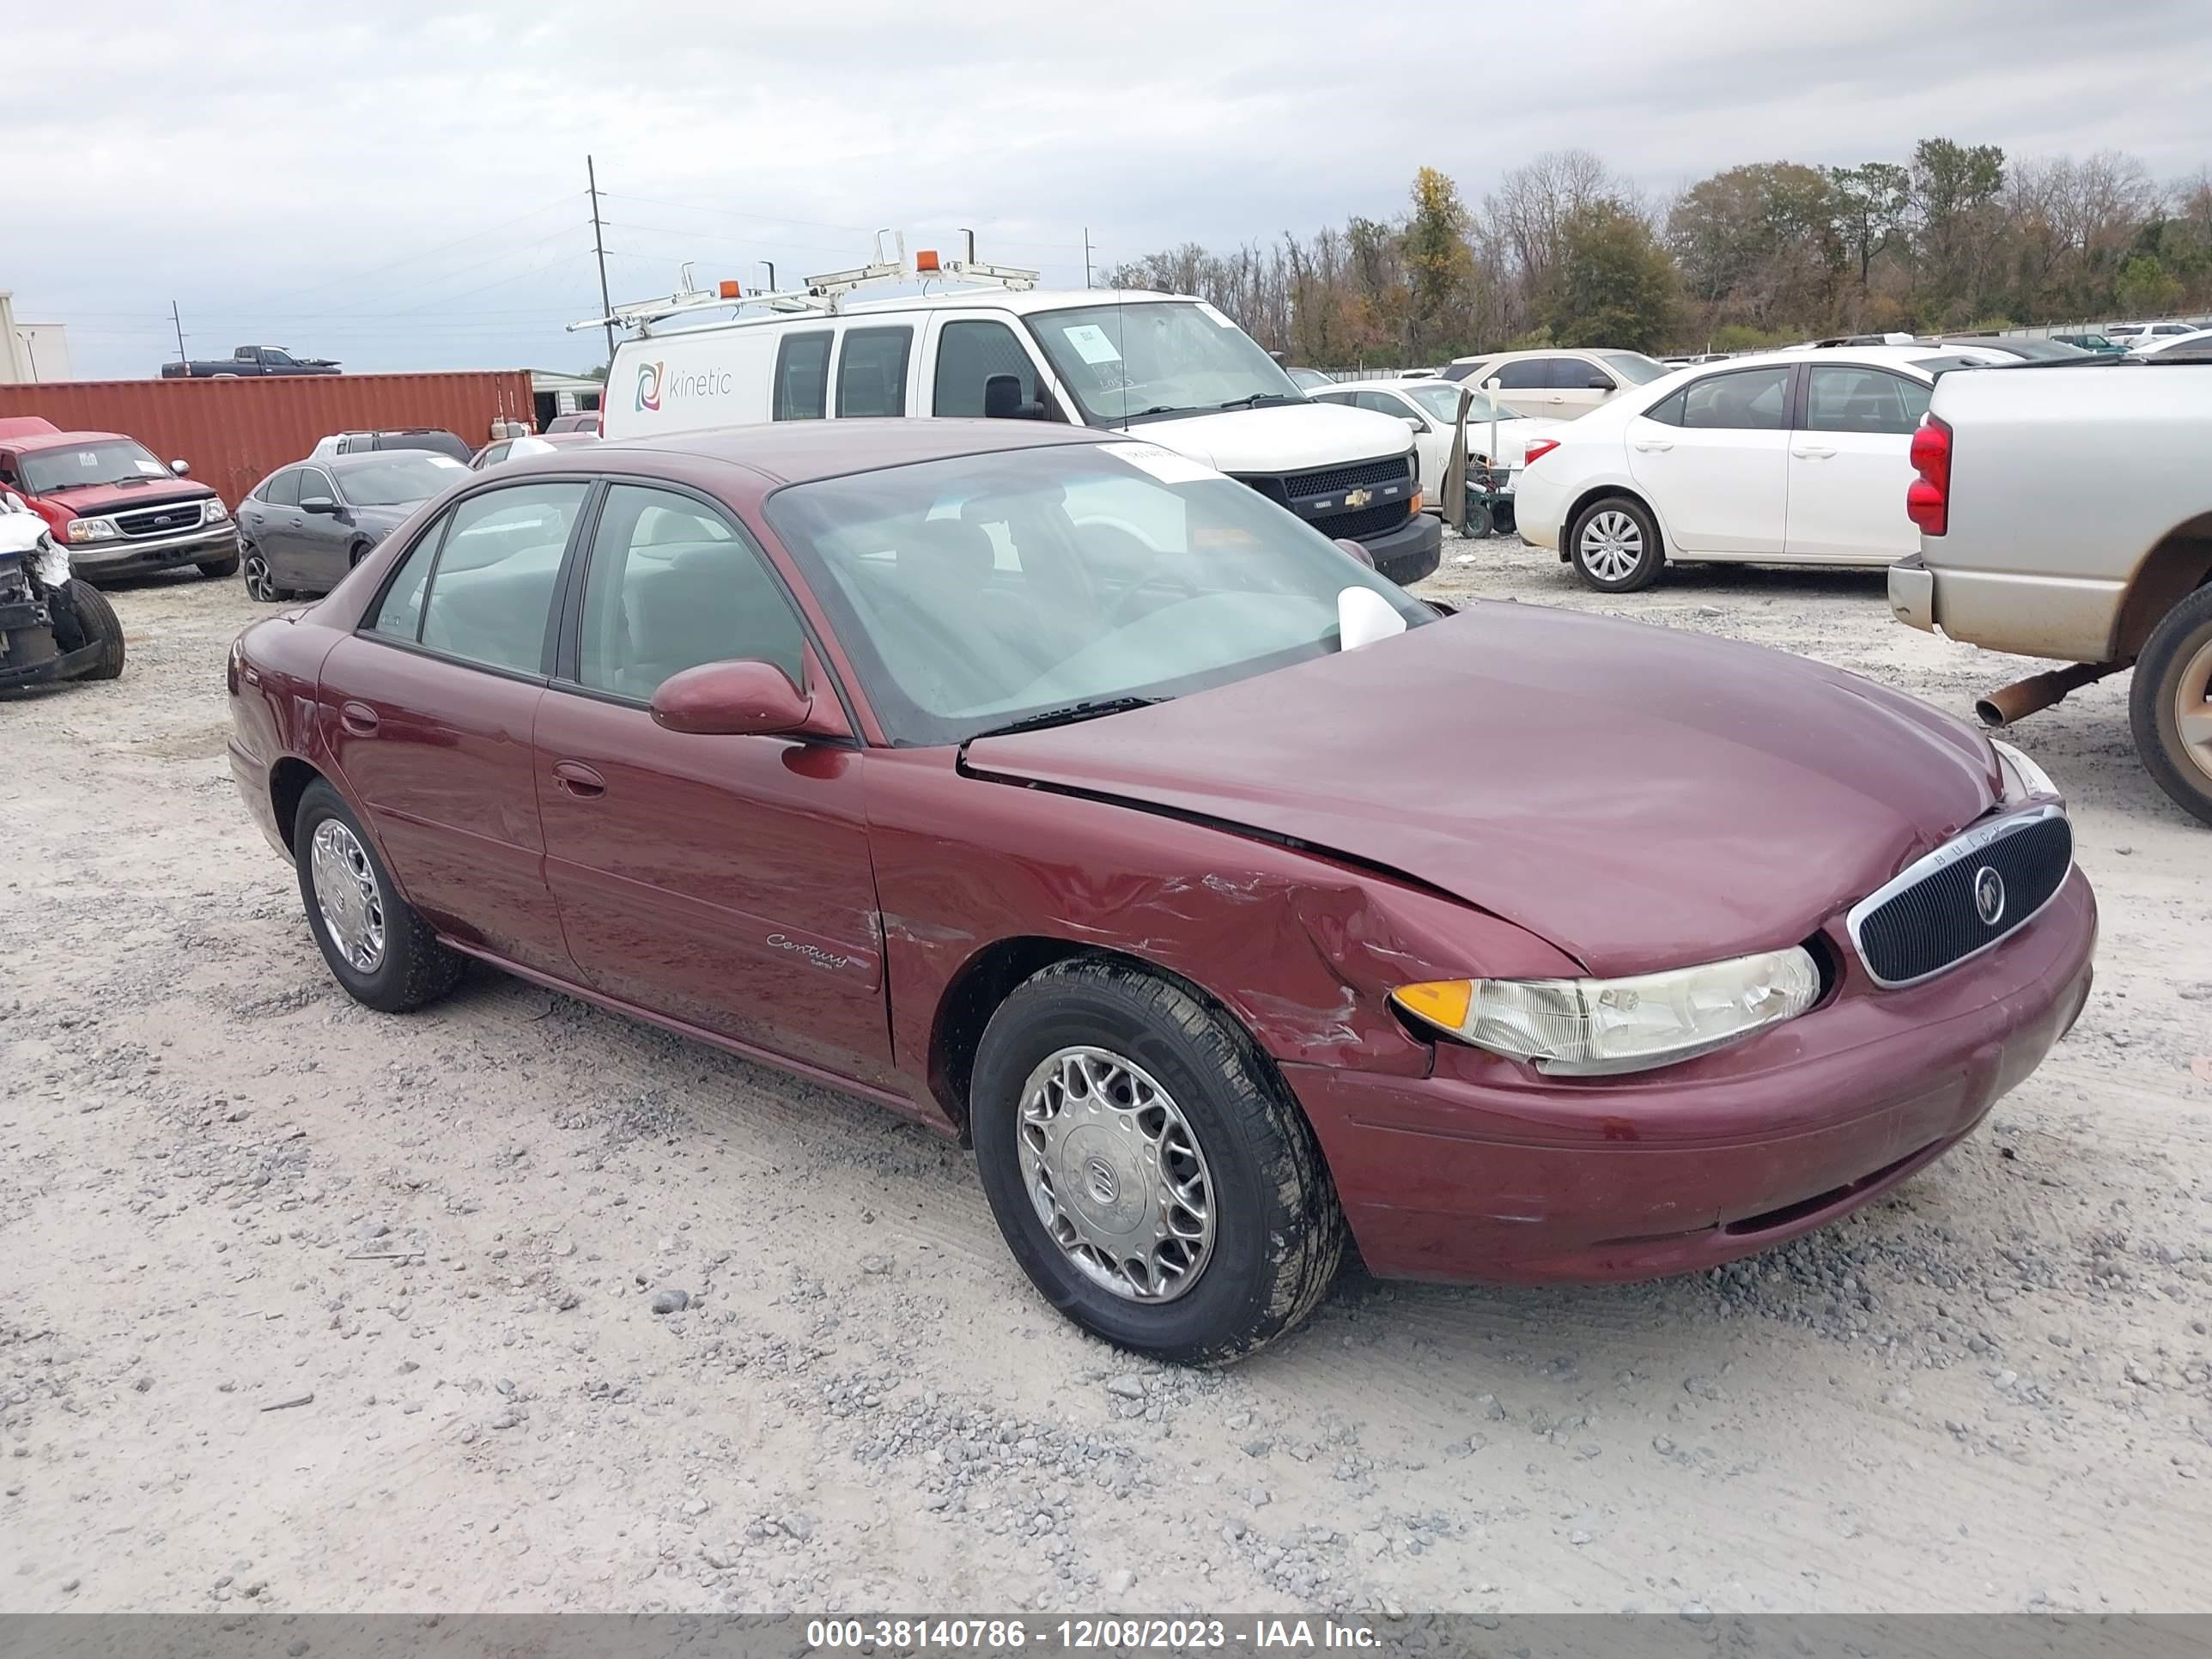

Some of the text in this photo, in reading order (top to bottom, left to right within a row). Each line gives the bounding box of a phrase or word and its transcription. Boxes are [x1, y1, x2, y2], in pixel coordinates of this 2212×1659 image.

[669, 367, 732, 398] kinetic
[1934, 825, 2001, 866] BUICK
[766, 933, 848, 968] Century
